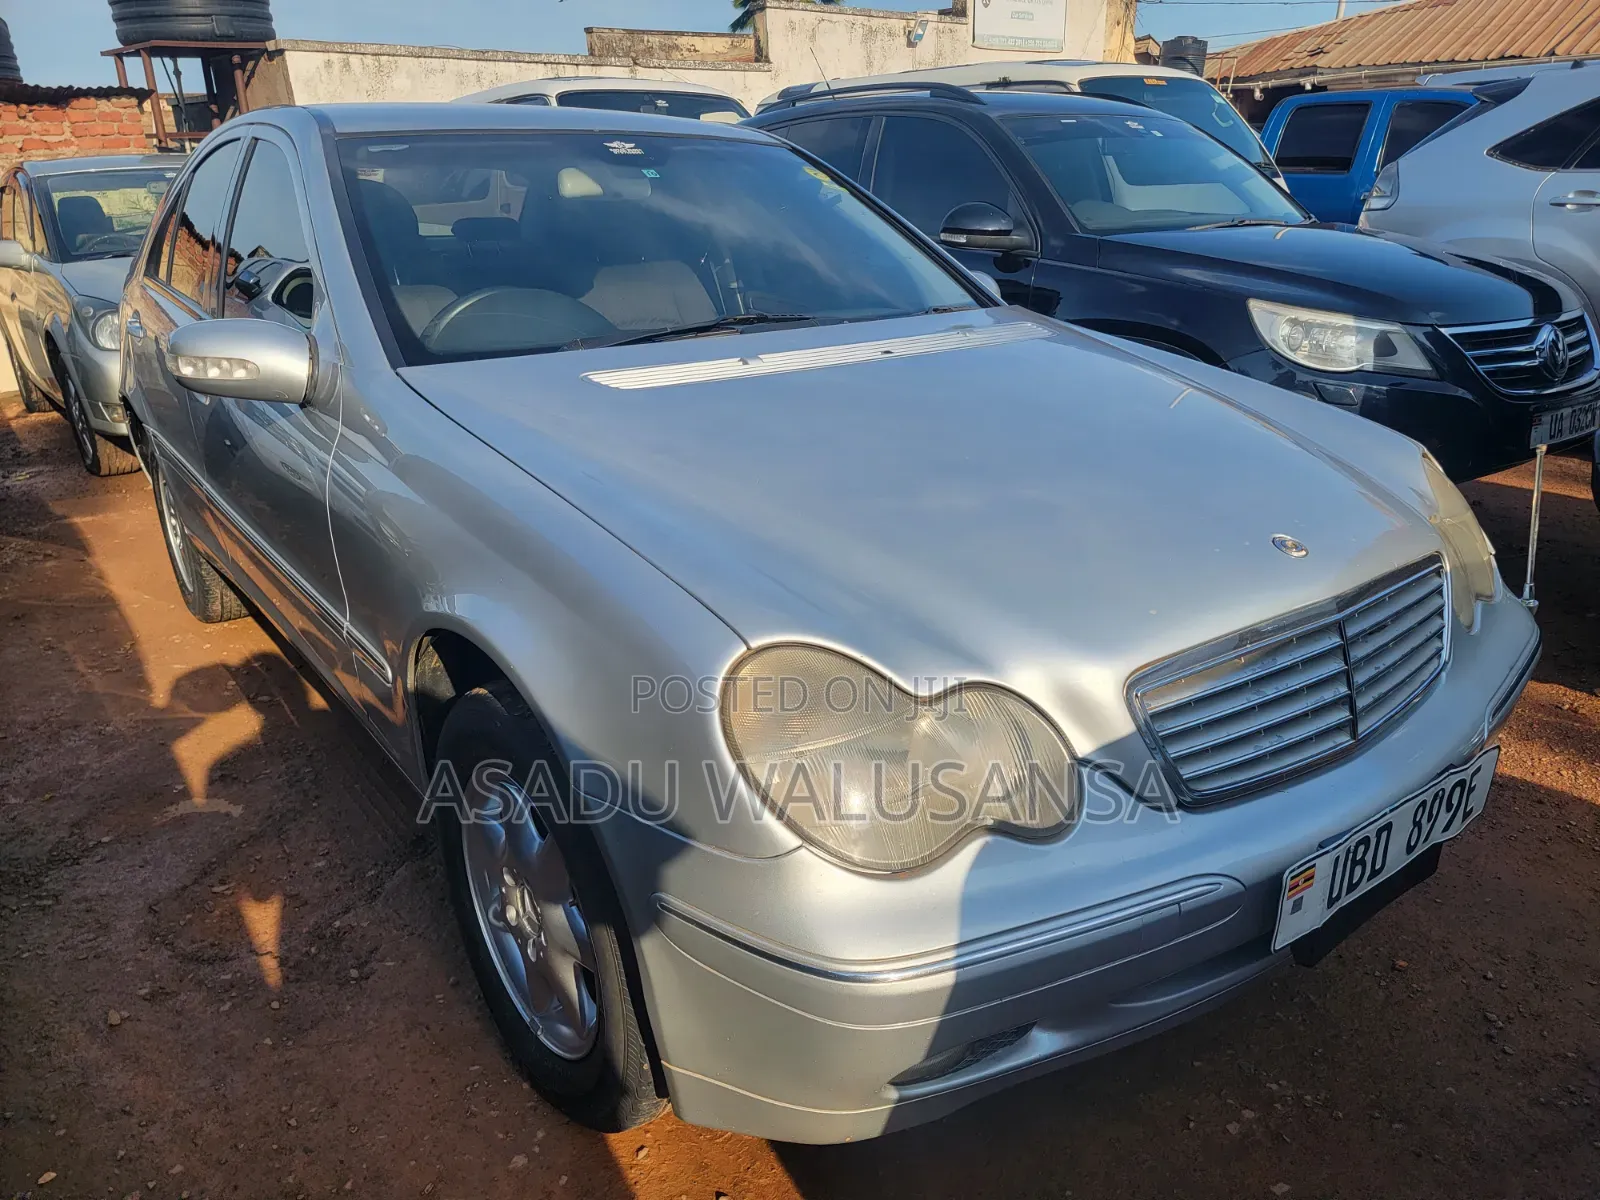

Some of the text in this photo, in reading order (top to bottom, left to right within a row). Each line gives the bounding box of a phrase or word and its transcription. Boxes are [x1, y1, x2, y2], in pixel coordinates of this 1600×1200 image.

[1549, 412, 1564, 440] UA
[1327, 764, 1483, 910] UBD 899E
